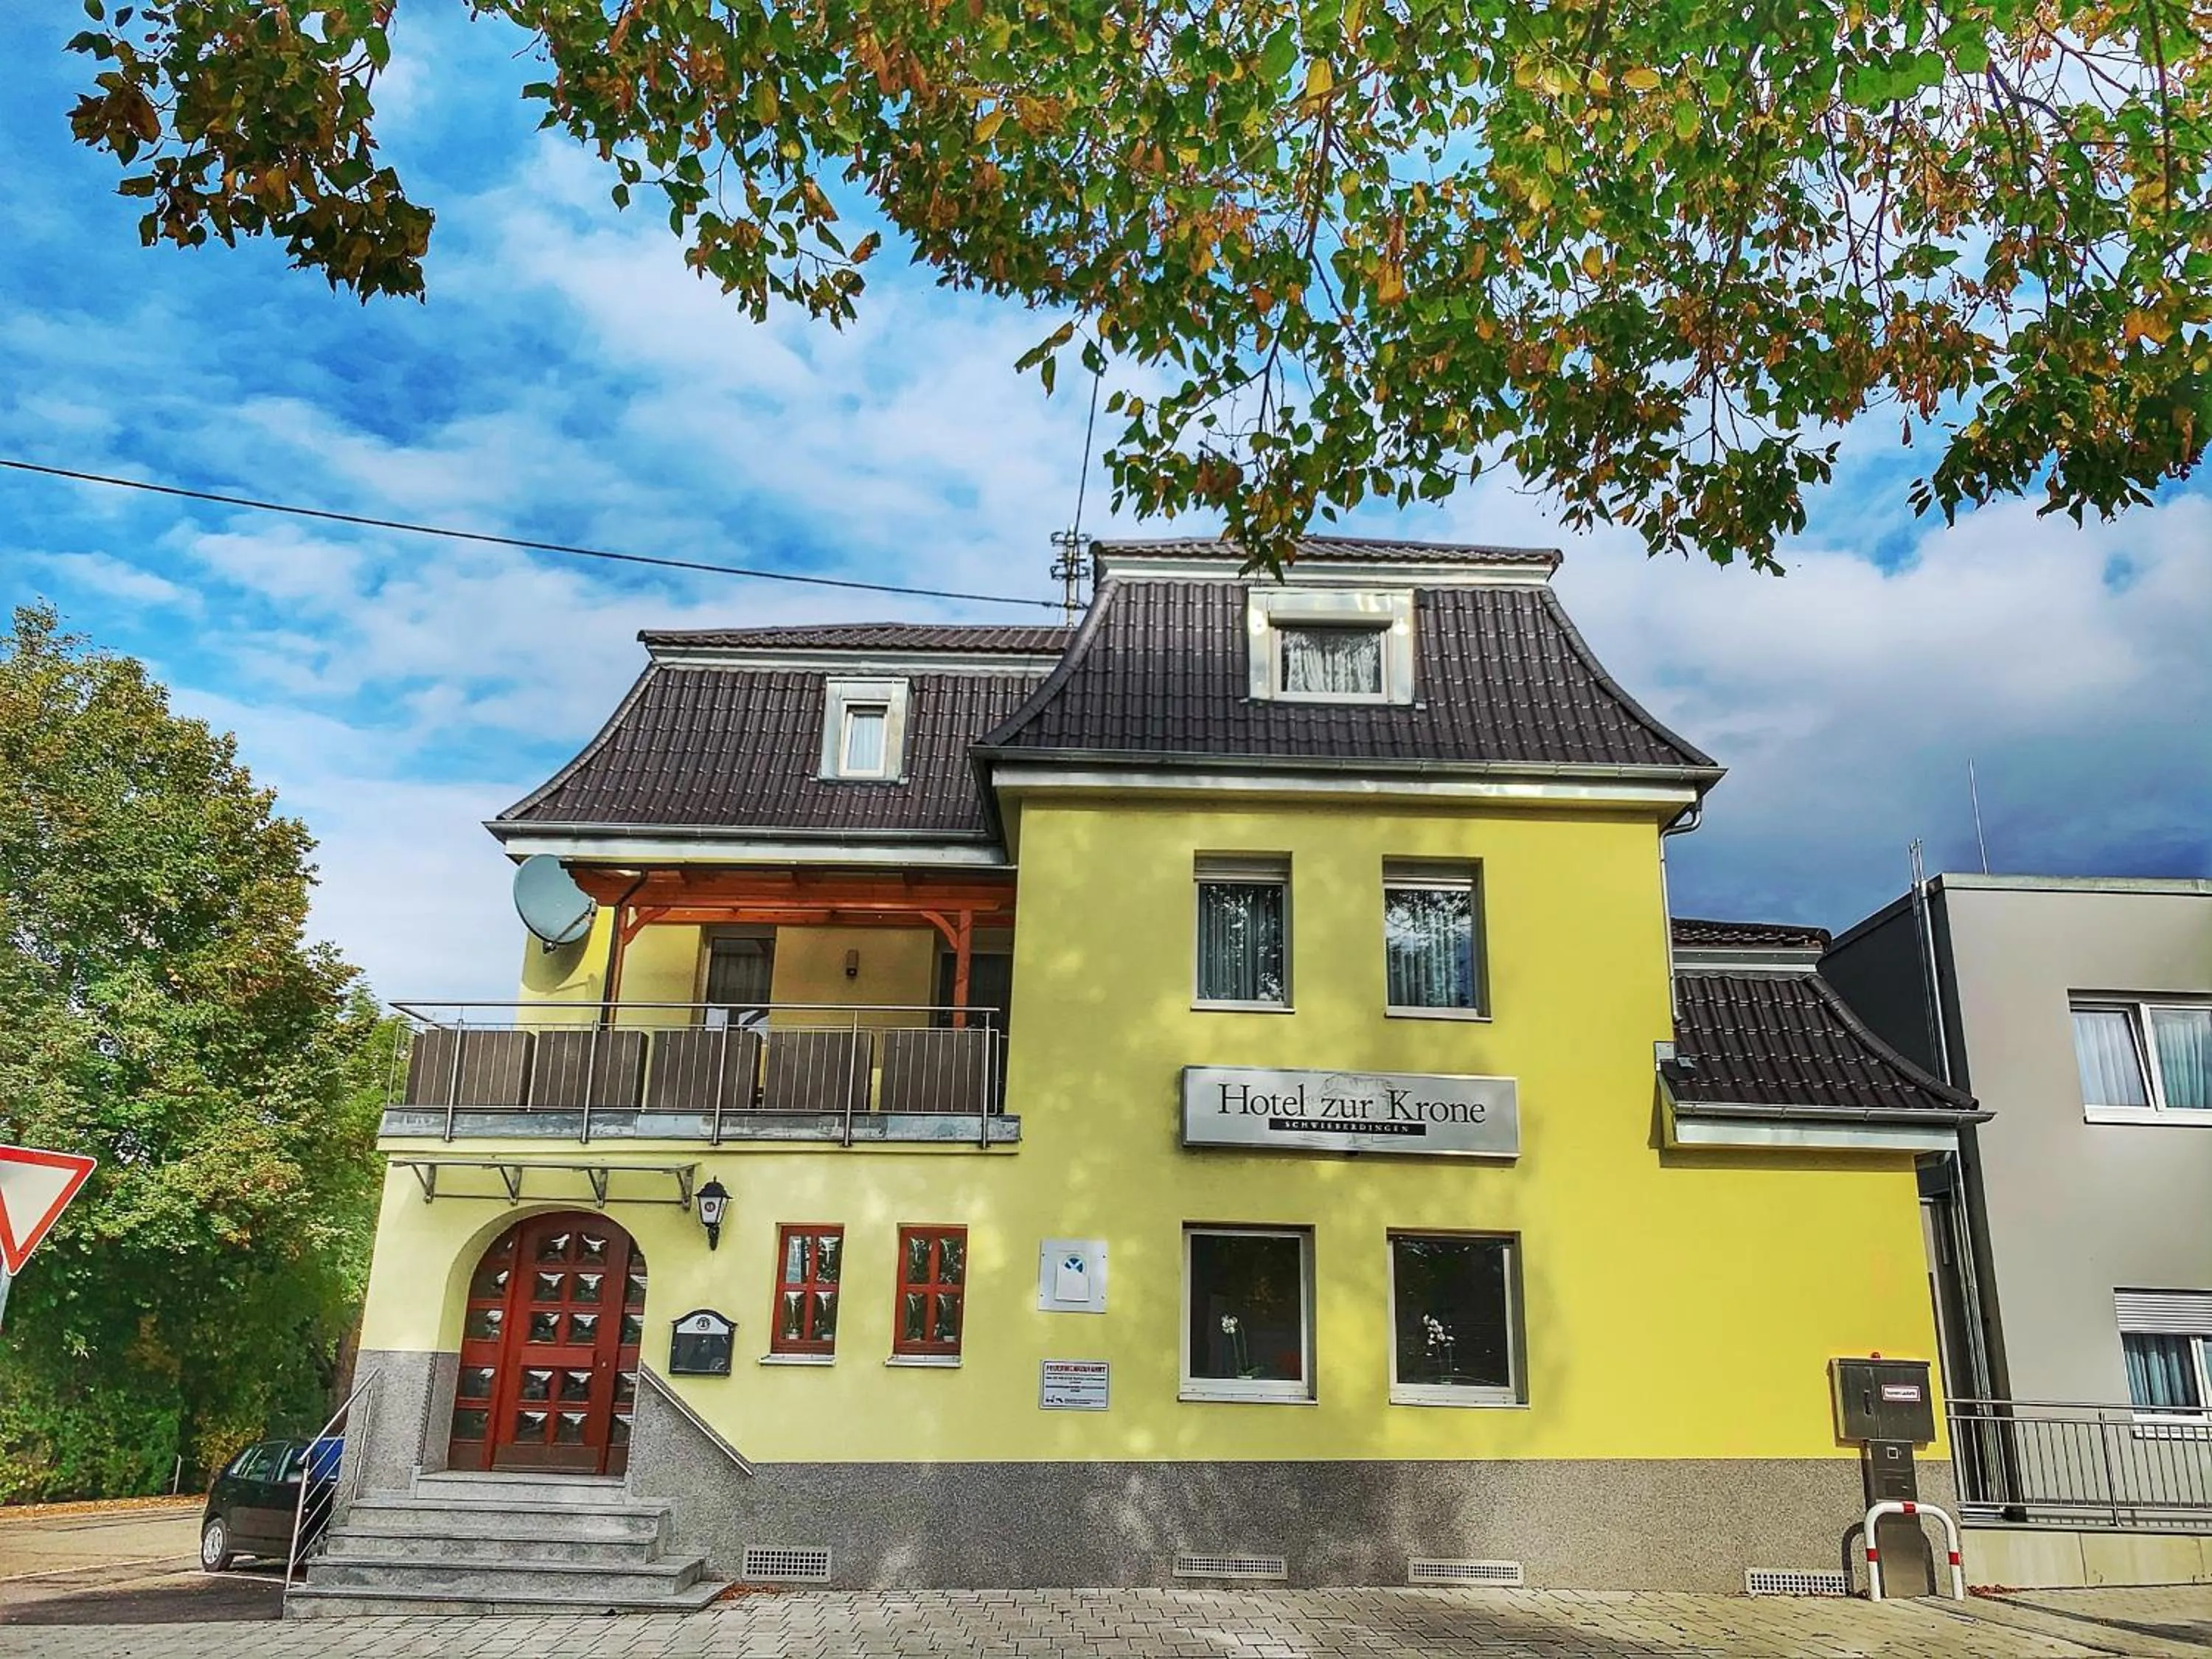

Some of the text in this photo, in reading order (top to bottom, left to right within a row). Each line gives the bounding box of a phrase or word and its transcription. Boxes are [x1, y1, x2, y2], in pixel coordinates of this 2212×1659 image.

[1217, 1083, 1486, 1124] Hotel zur Krone
[1285, 1120, 1409, 1133] SCHWIEBERDINGEN
